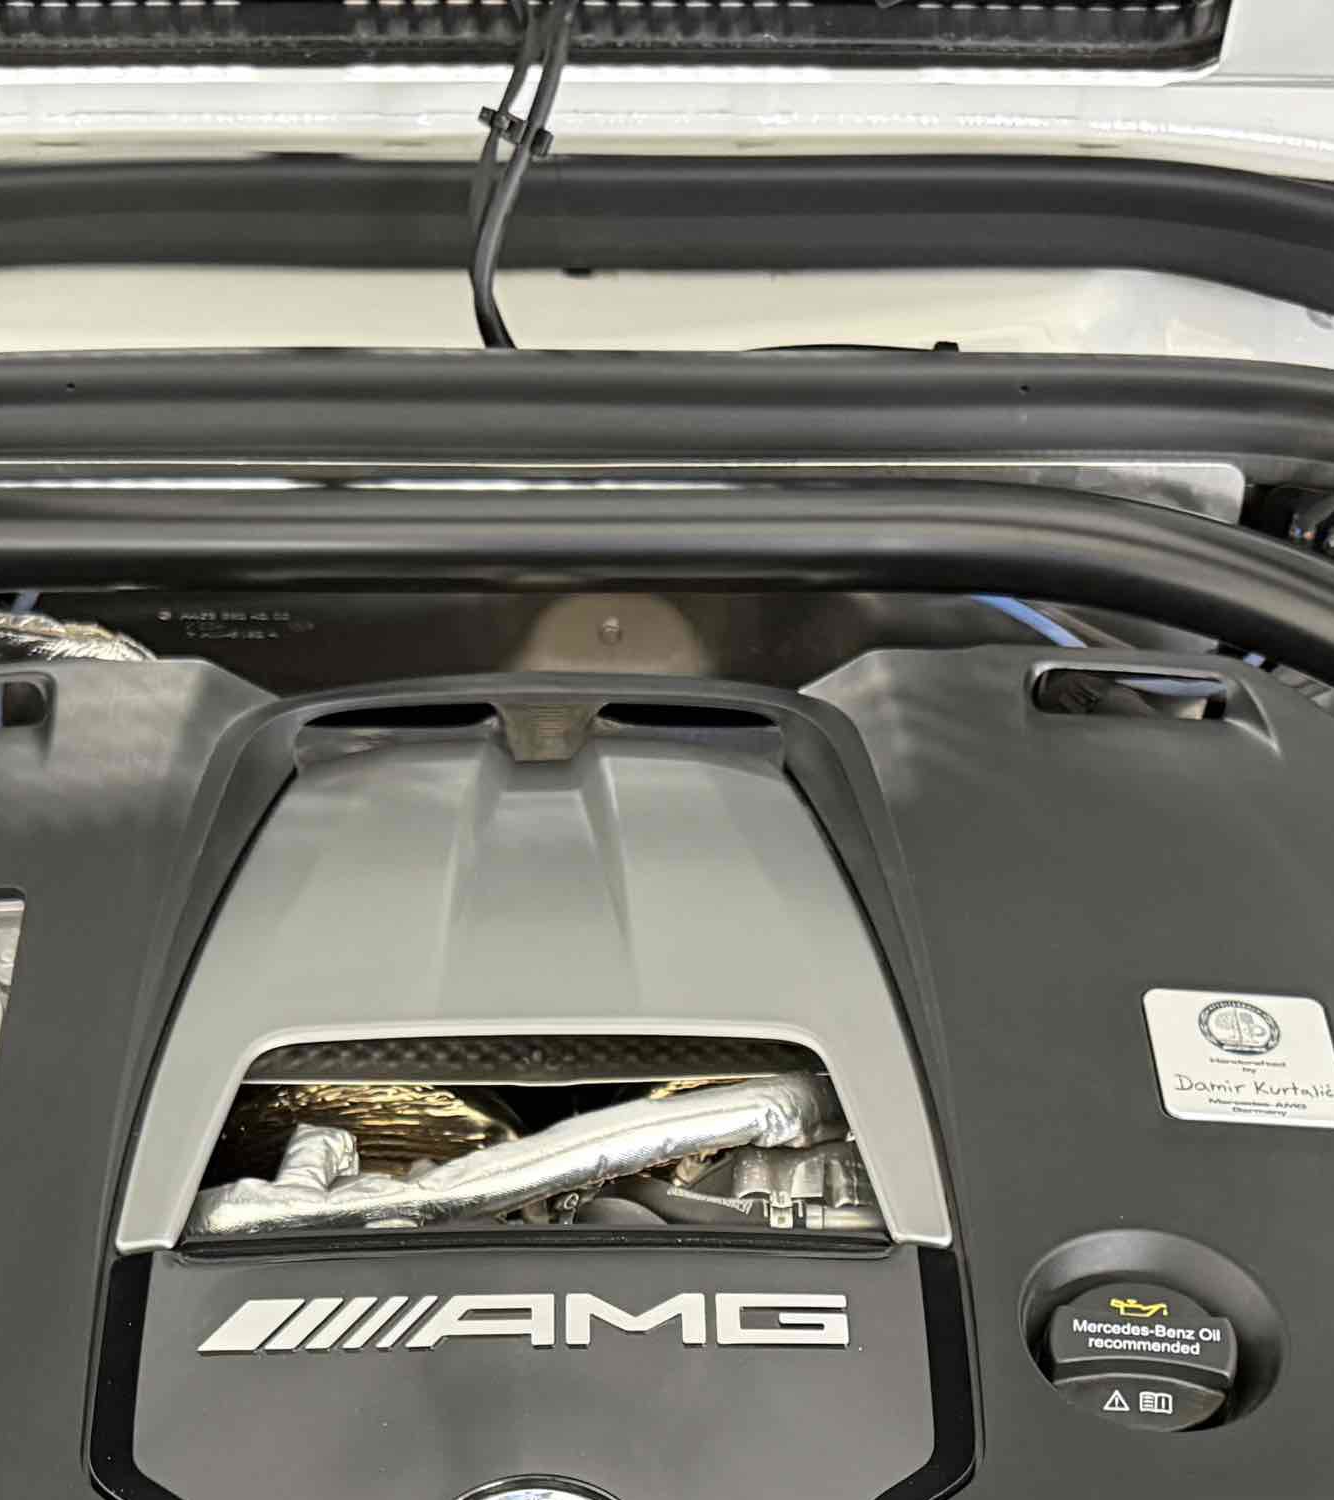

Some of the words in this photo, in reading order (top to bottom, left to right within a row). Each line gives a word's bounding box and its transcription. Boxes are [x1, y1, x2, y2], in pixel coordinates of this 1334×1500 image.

[1174, 1073, 1246, 1095] Damir
[406, 1292, 849, 1349] AMG
[1072, 1319, 1195, 1341] Mercedes-Benz
[1198, 1327, 1221, 1342] Oil
[1088, 1336, 1200, 1355] recommended
